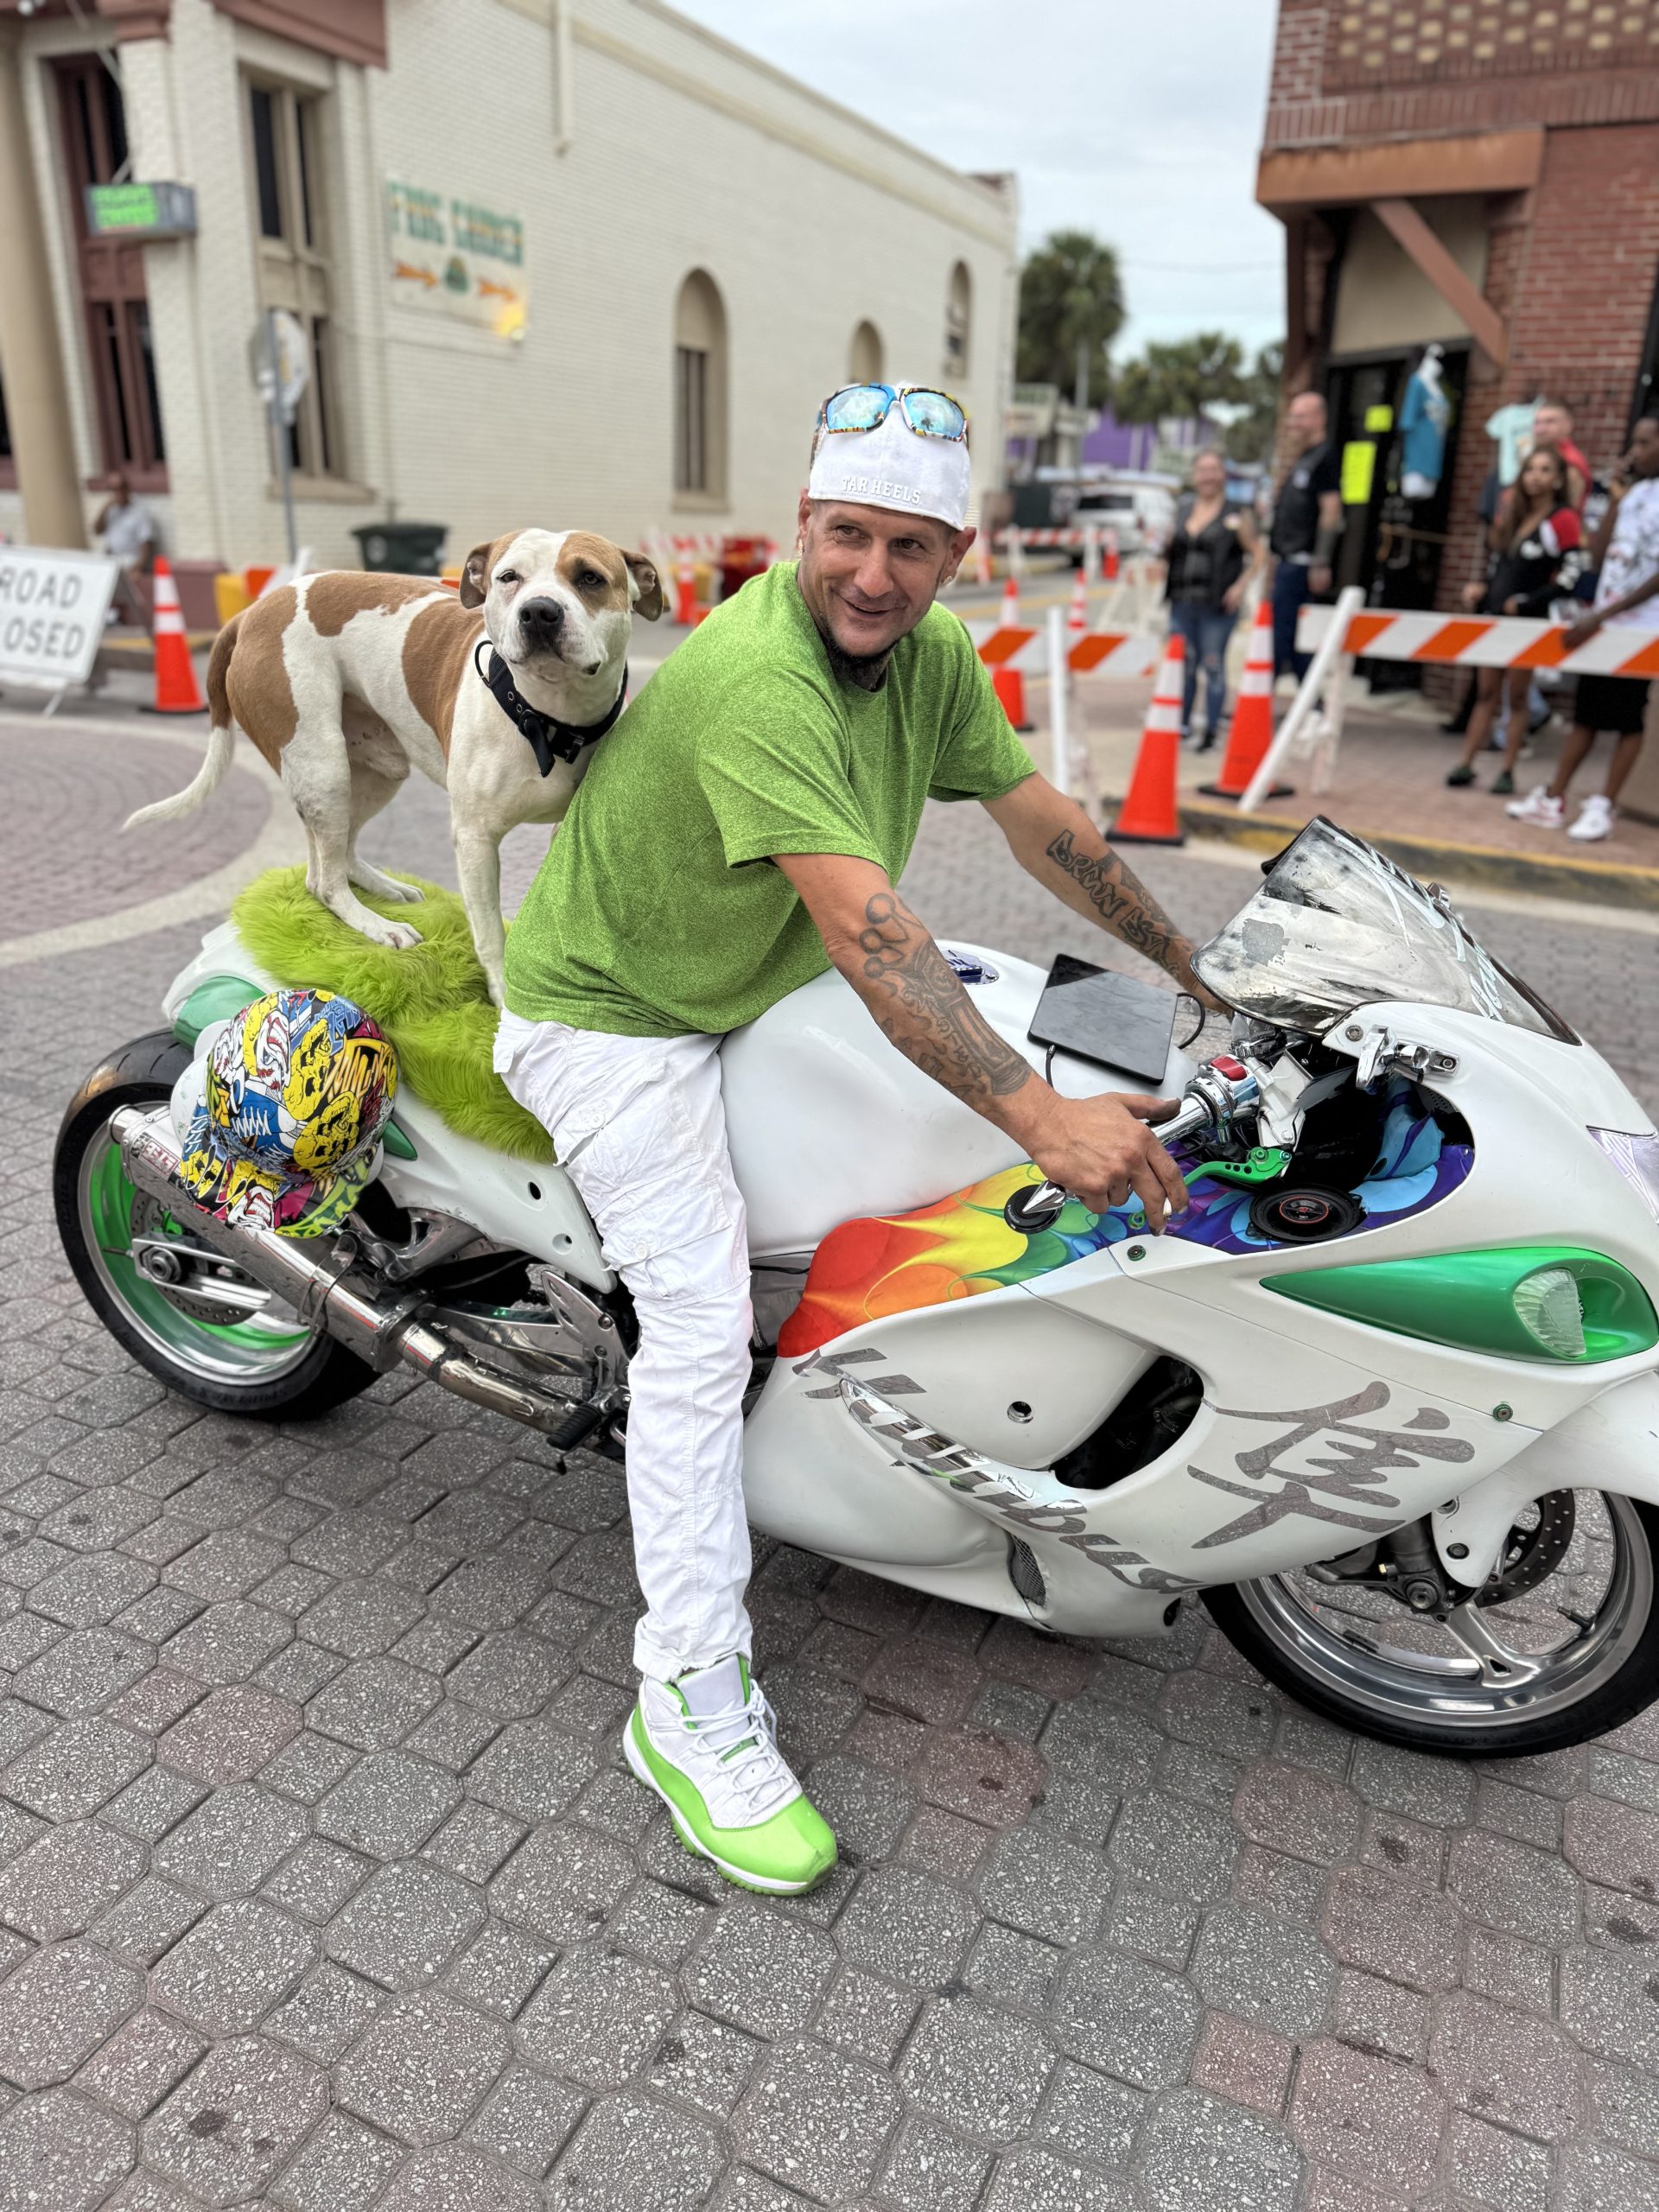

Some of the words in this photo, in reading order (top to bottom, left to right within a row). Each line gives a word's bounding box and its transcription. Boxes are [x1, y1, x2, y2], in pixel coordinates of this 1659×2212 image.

[842, 476, 869, 493] TAR
[872, 479, 922, 505] HEELS
[0, 565, 82, 609] ROAD
[3, 616, 86, 659] OSED
